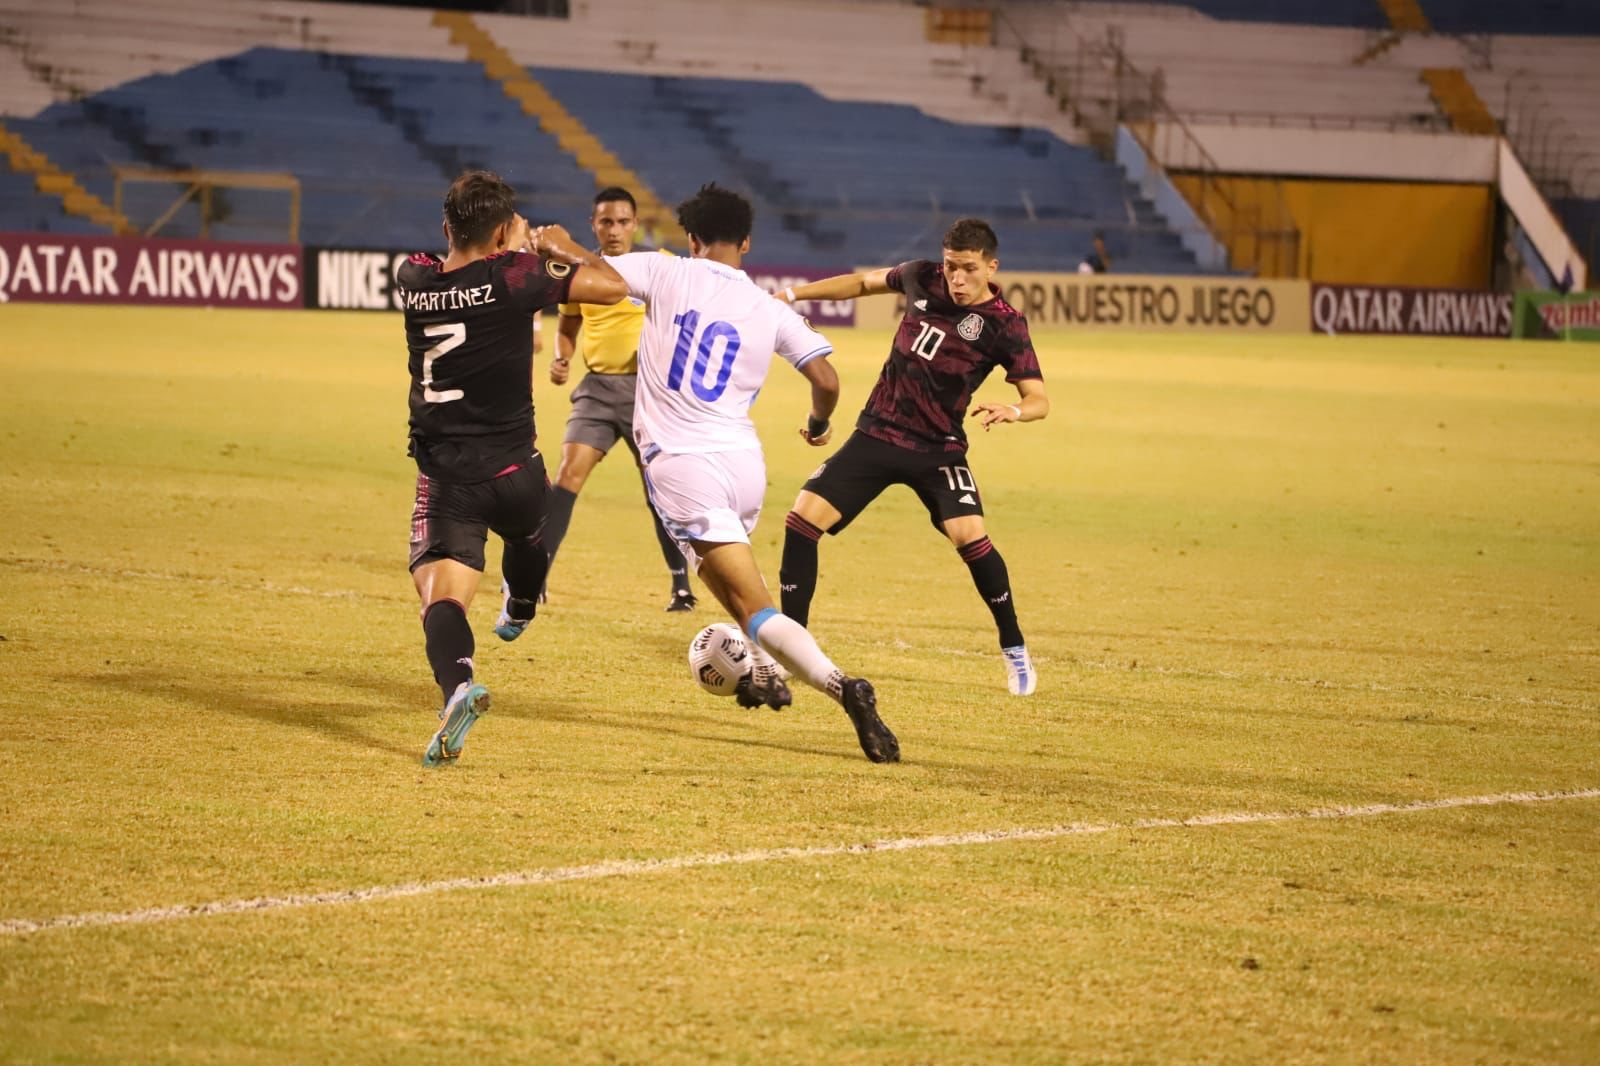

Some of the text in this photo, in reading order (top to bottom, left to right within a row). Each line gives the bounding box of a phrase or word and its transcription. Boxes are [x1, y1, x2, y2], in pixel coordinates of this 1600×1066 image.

[0, 244, 299, 303] ATAR AIRWAYS
[318, 250, 389, 308] NIKE
[406, 284, 497, 311] MARTÍNEZ
[1005, 283, 1275, 326] OR NUESTRO JUEGO
[1313, 287, 1514, 336] QATAR AIRWAYS
[420, 322, 467, 404] 2
[667, 309, 741, 402] 10
[911, 321, 946, 361] 10
[938, 465, 977, 493] 10
